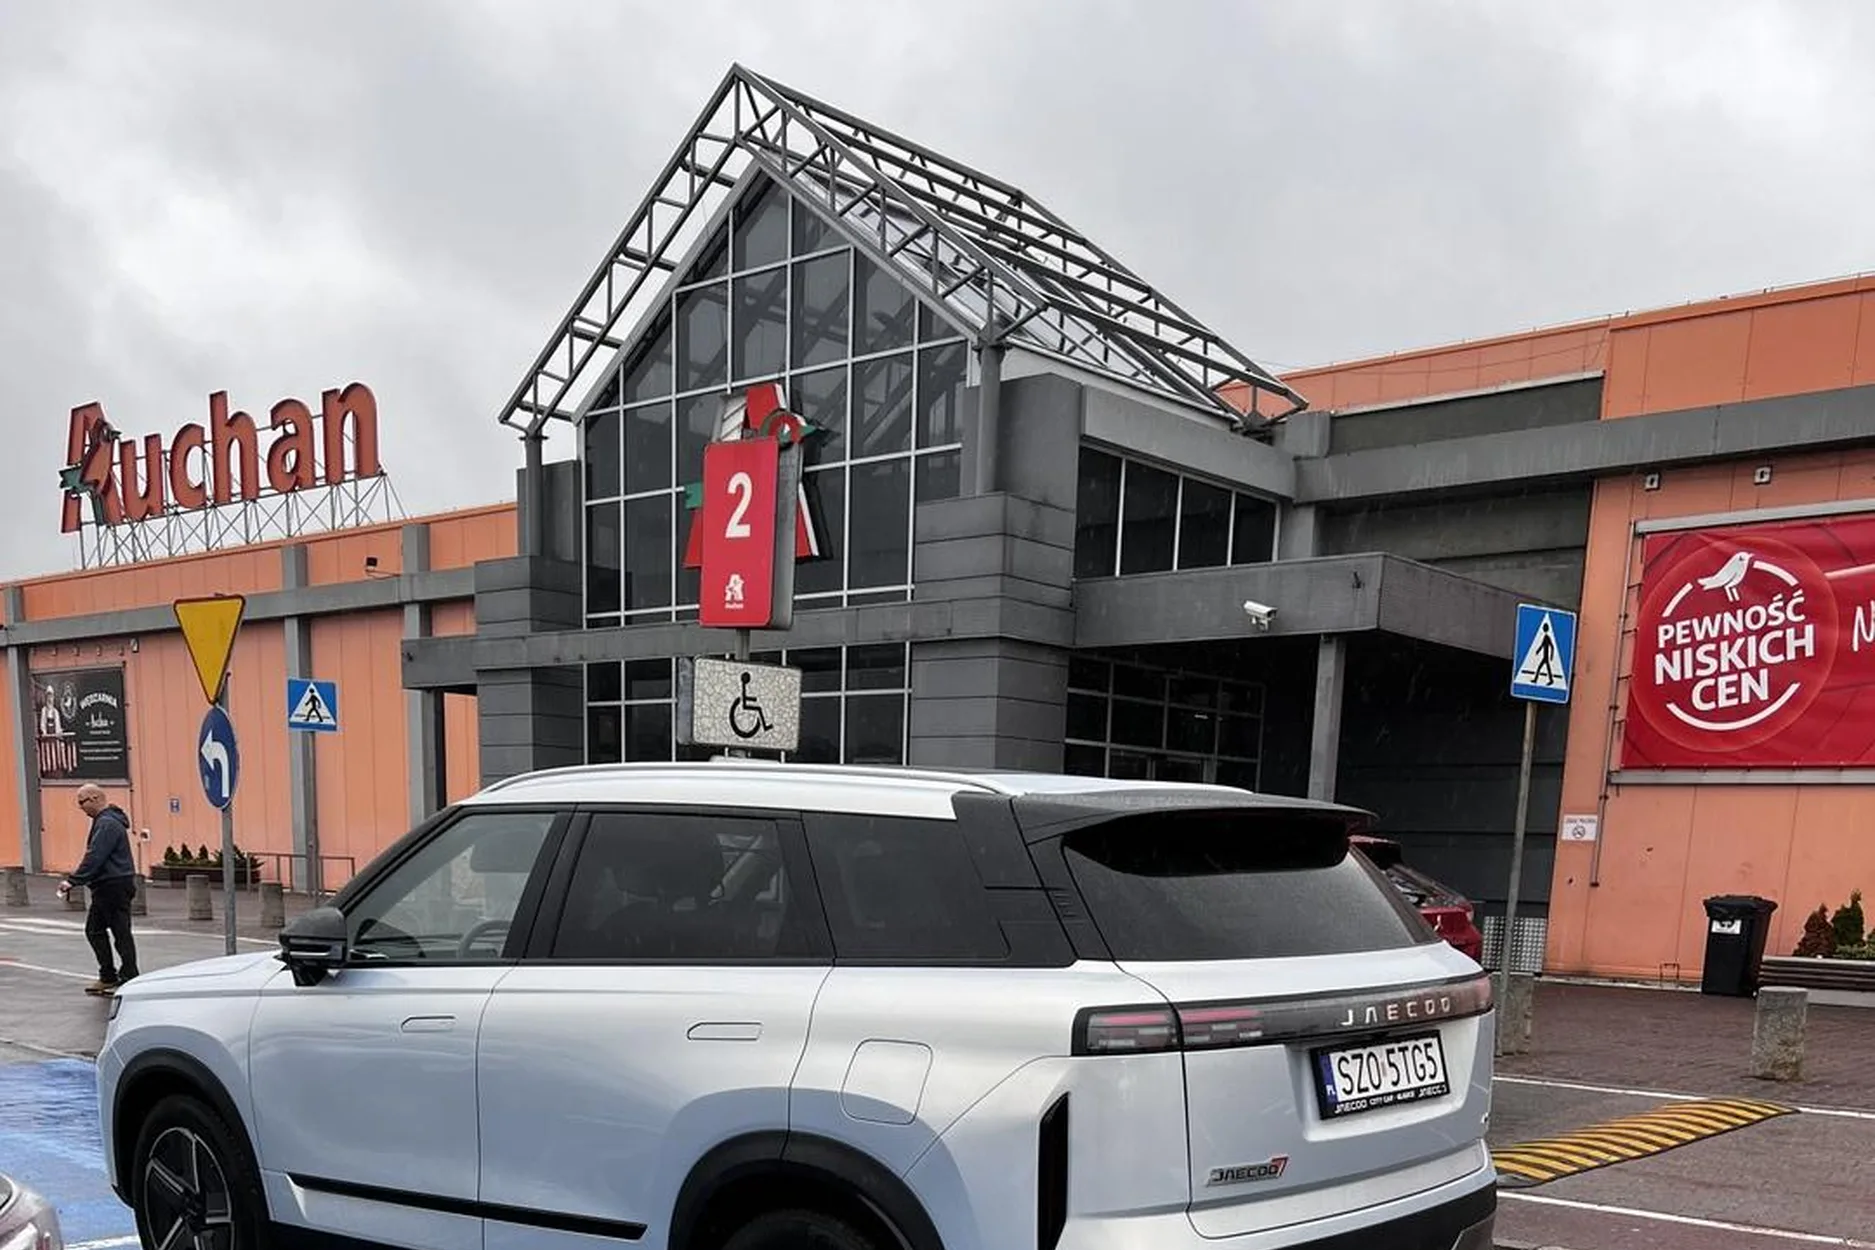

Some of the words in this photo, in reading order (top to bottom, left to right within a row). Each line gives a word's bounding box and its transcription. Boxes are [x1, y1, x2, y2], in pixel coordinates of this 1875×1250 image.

[61, 382, 380, 533] Auchan
[724, 472, 753, 539] 2
[1658, 588, 1805, 648] PEWNOŚĆ
[1655, 624, 1814, 685] NISKICH
[1692, 668, 1769, 711] CEN
[1341, 997, 1450, 1026] JAECOO
[1386, 1042, 1438, 1087] 5TG5
